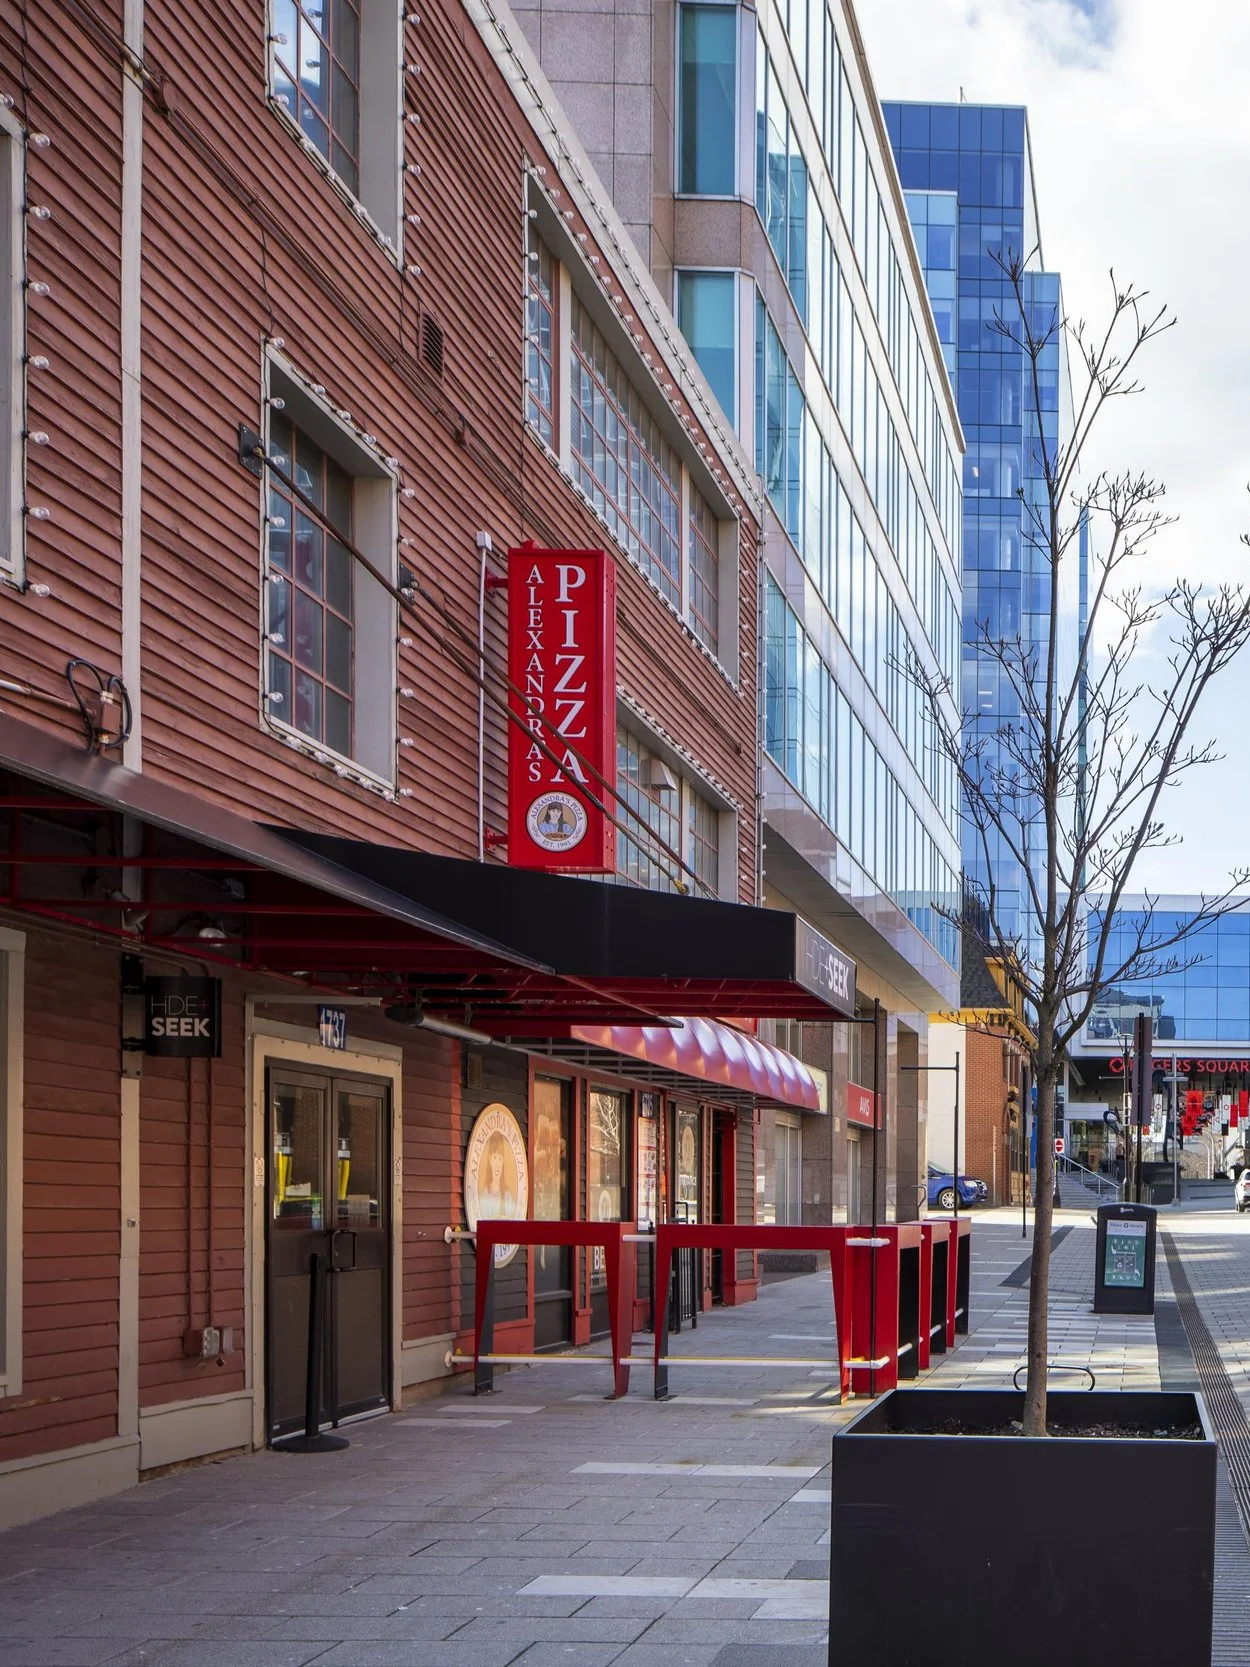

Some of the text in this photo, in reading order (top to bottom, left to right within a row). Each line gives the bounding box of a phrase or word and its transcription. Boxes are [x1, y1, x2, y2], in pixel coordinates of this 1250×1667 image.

[550, 564, 589, 783] PIZZA
[531, 795, 583, 821] ALEXANDRA'S PIZZA
[152, 1017, 210, 1037] SEEK
[320, 1006, 346, 1049] 1737
[859, 1096, 870, 1117] AVIS
